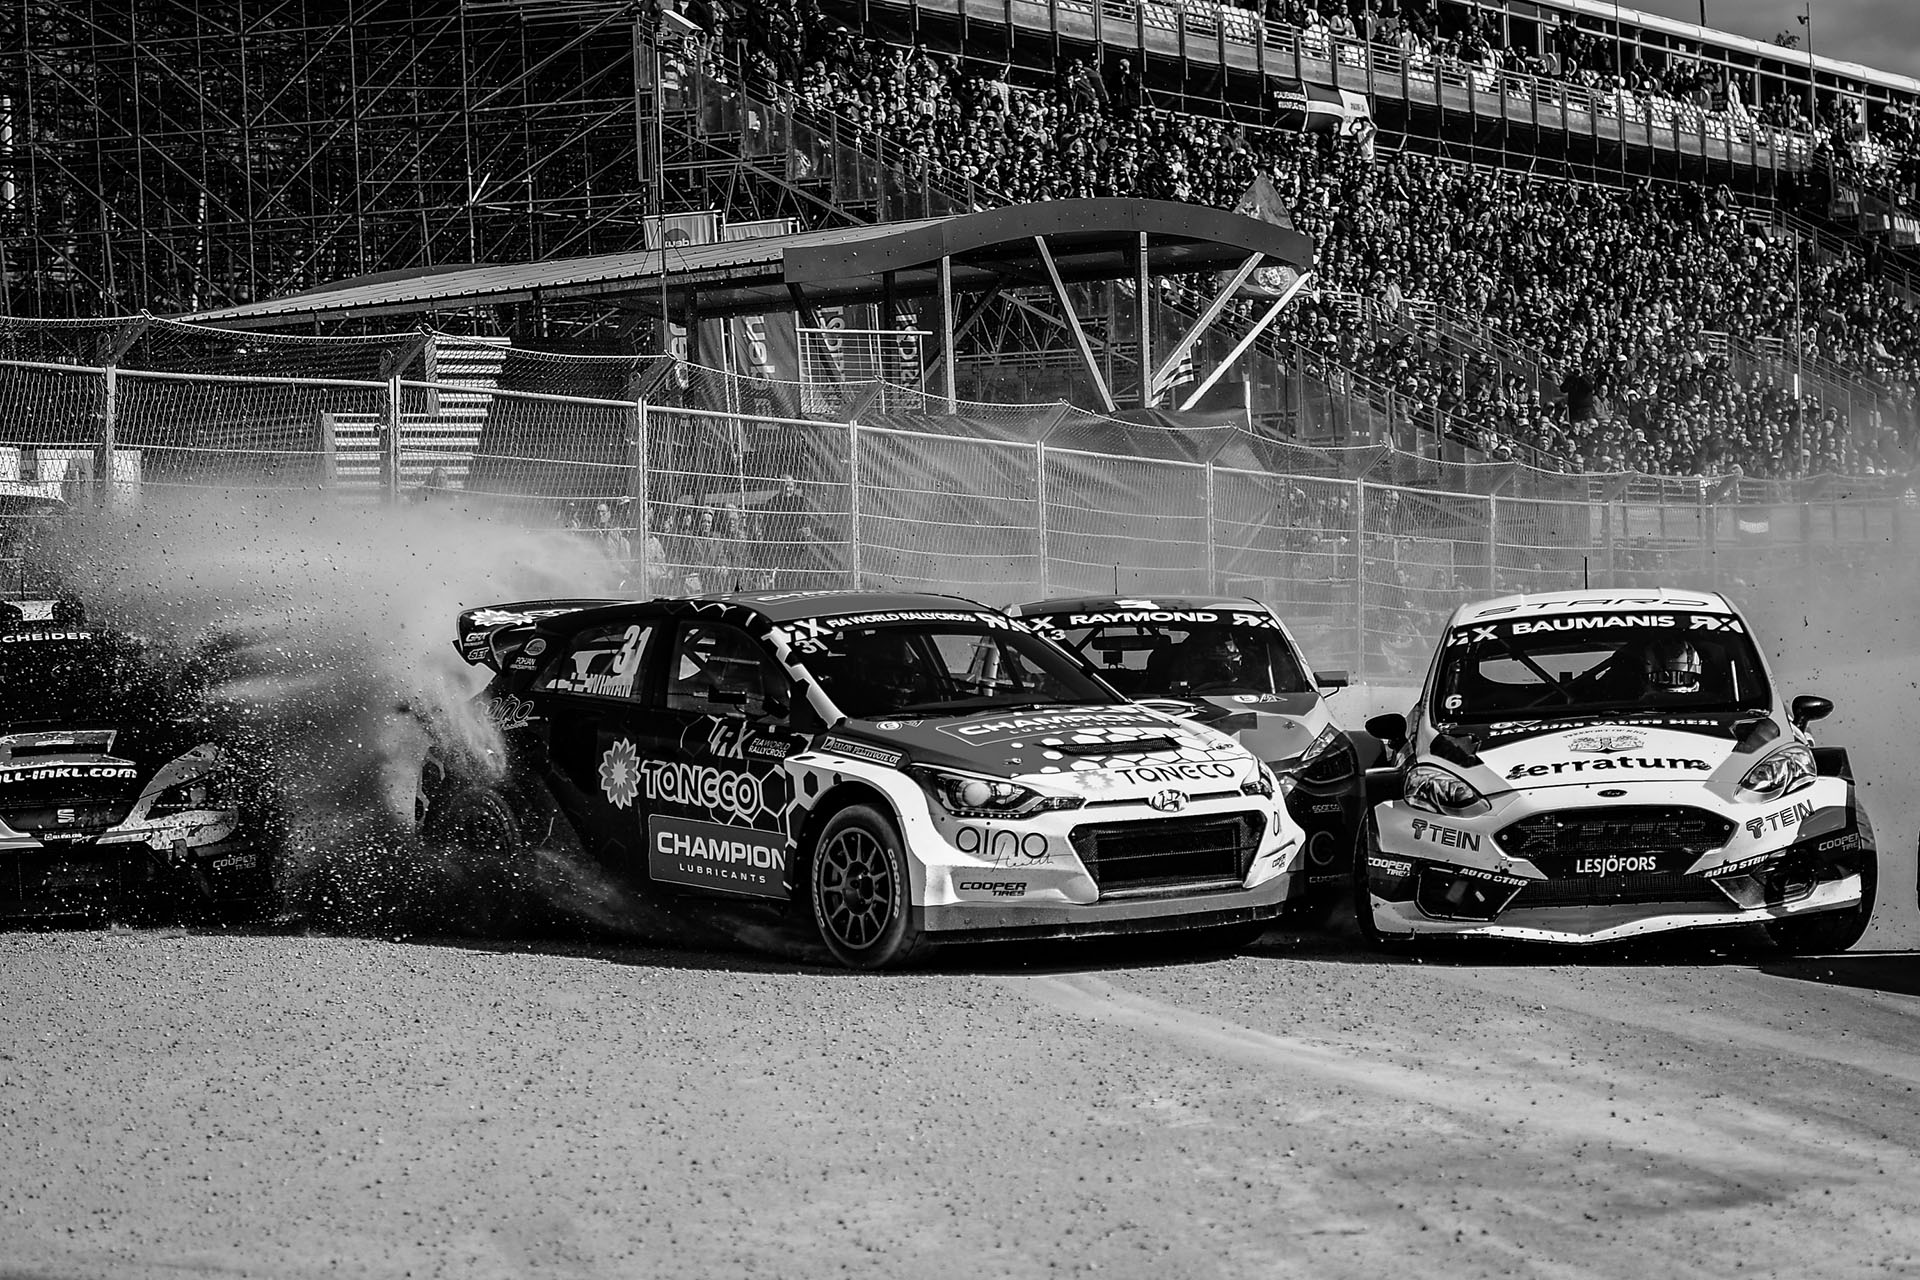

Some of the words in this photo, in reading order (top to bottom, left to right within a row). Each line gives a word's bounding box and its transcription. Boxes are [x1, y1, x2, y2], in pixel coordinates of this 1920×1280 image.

[826, 618, 852, 628] FIA
[849, 613, 900, 626] WORLD
[899, 611, 977, 623] RALLYCROSS
[1069, 612, 1218, 626] RAYMOND
[1512, 614, 1676, 635] BAUMANIS
[0, 632, 93, 643] CHEIDER
[794, 637, 828, 654] 31
[612, 624, 653, 675] 31
[1444, 694, 1463, 710] 6
[958, 714, 1154, 736] CHAMPION
[748, 745, 787, 758] RALLYCROSS
[751, 737, 764, 747] FIA
[763, 740, 791, 750] WORLD
[1508, 756, 1711, 780] ferratum
[1764, 799, 1816, 832] TEIN
[1428, 823, 1481, 852] TEIN
[656, 831, 786, 871] CHAMPION
[1367, 857, 1412, 871] COOPER
[1575, 854, 1657, 878] LESJÖFORS
[1703, 862, 1738, 878] AUTO
[679, 863, 767, 884] LUBRICANTS
[1458, 868, 1493, 881] AUTO
[887, 848, 901, 920] COOPER
[959, 881, 1028, 891] COOPER
